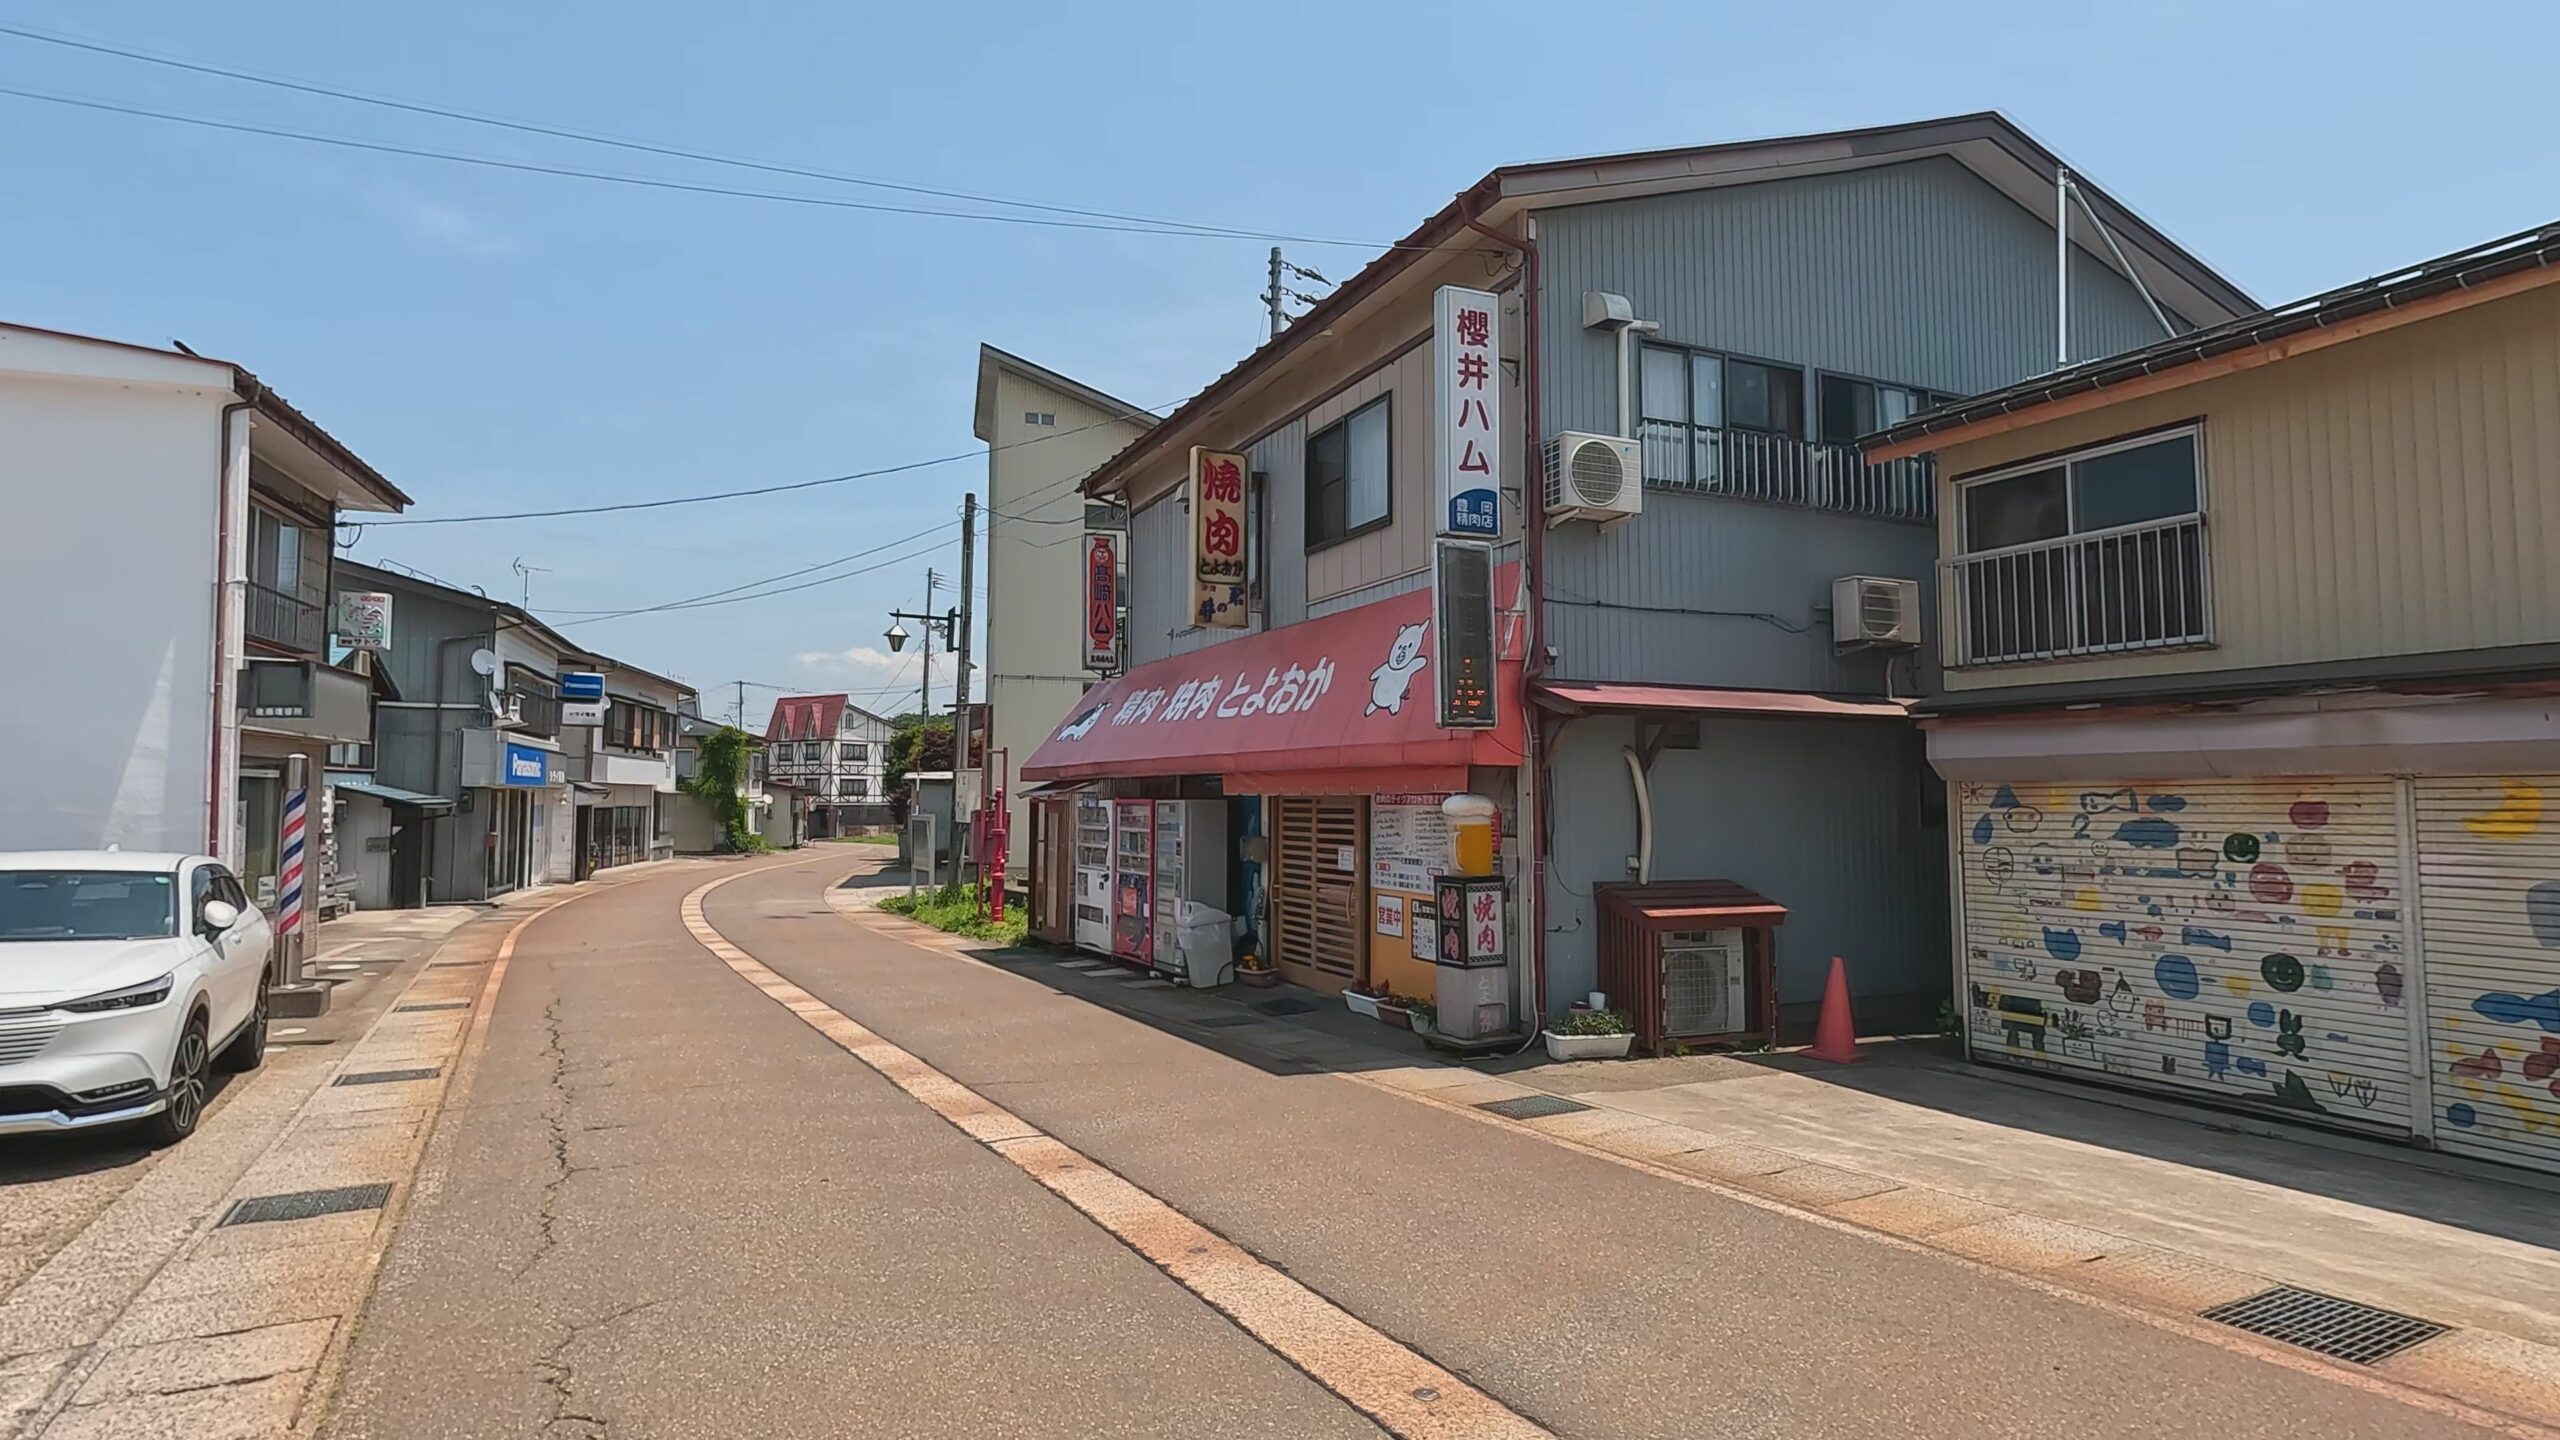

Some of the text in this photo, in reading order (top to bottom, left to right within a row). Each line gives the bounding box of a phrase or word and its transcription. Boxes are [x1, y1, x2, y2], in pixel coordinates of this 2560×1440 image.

[1457, 308, 1490, 476] 櫻井ハム
[1456, 512, 1494, 528] 精肉店
[1201, 558, 1243, 577] とよおか
[1216, 655, 1336, 719] とよおか
[512, 752, 542, 778] Panasonic
[1378, 905, 1403, 928] 営業中
[1473, 893, 1497, 954] 焼肉
